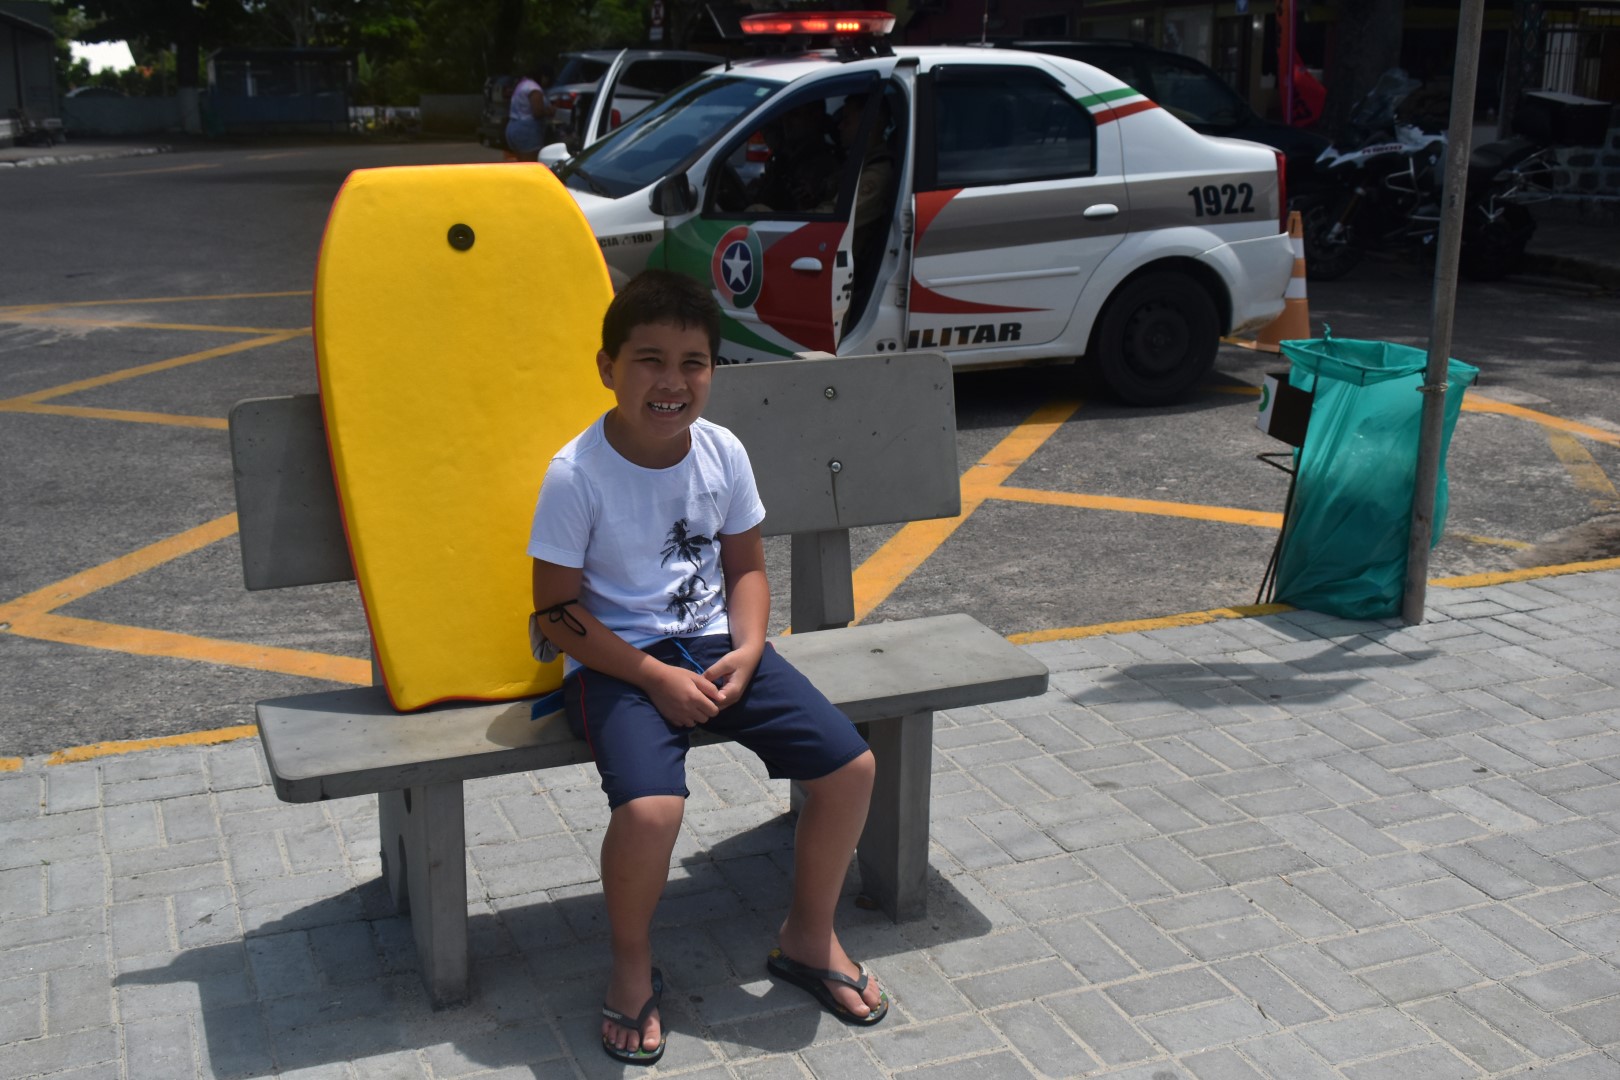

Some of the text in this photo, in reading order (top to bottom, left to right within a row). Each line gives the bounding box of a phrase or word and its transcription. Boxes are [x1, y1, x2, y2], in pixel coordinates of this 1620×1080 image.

[1187, 183, 1255, 217] 1922
[599, 232, 653, 248] CIA 190
[907, 322, 1022, 349] ILITAR
